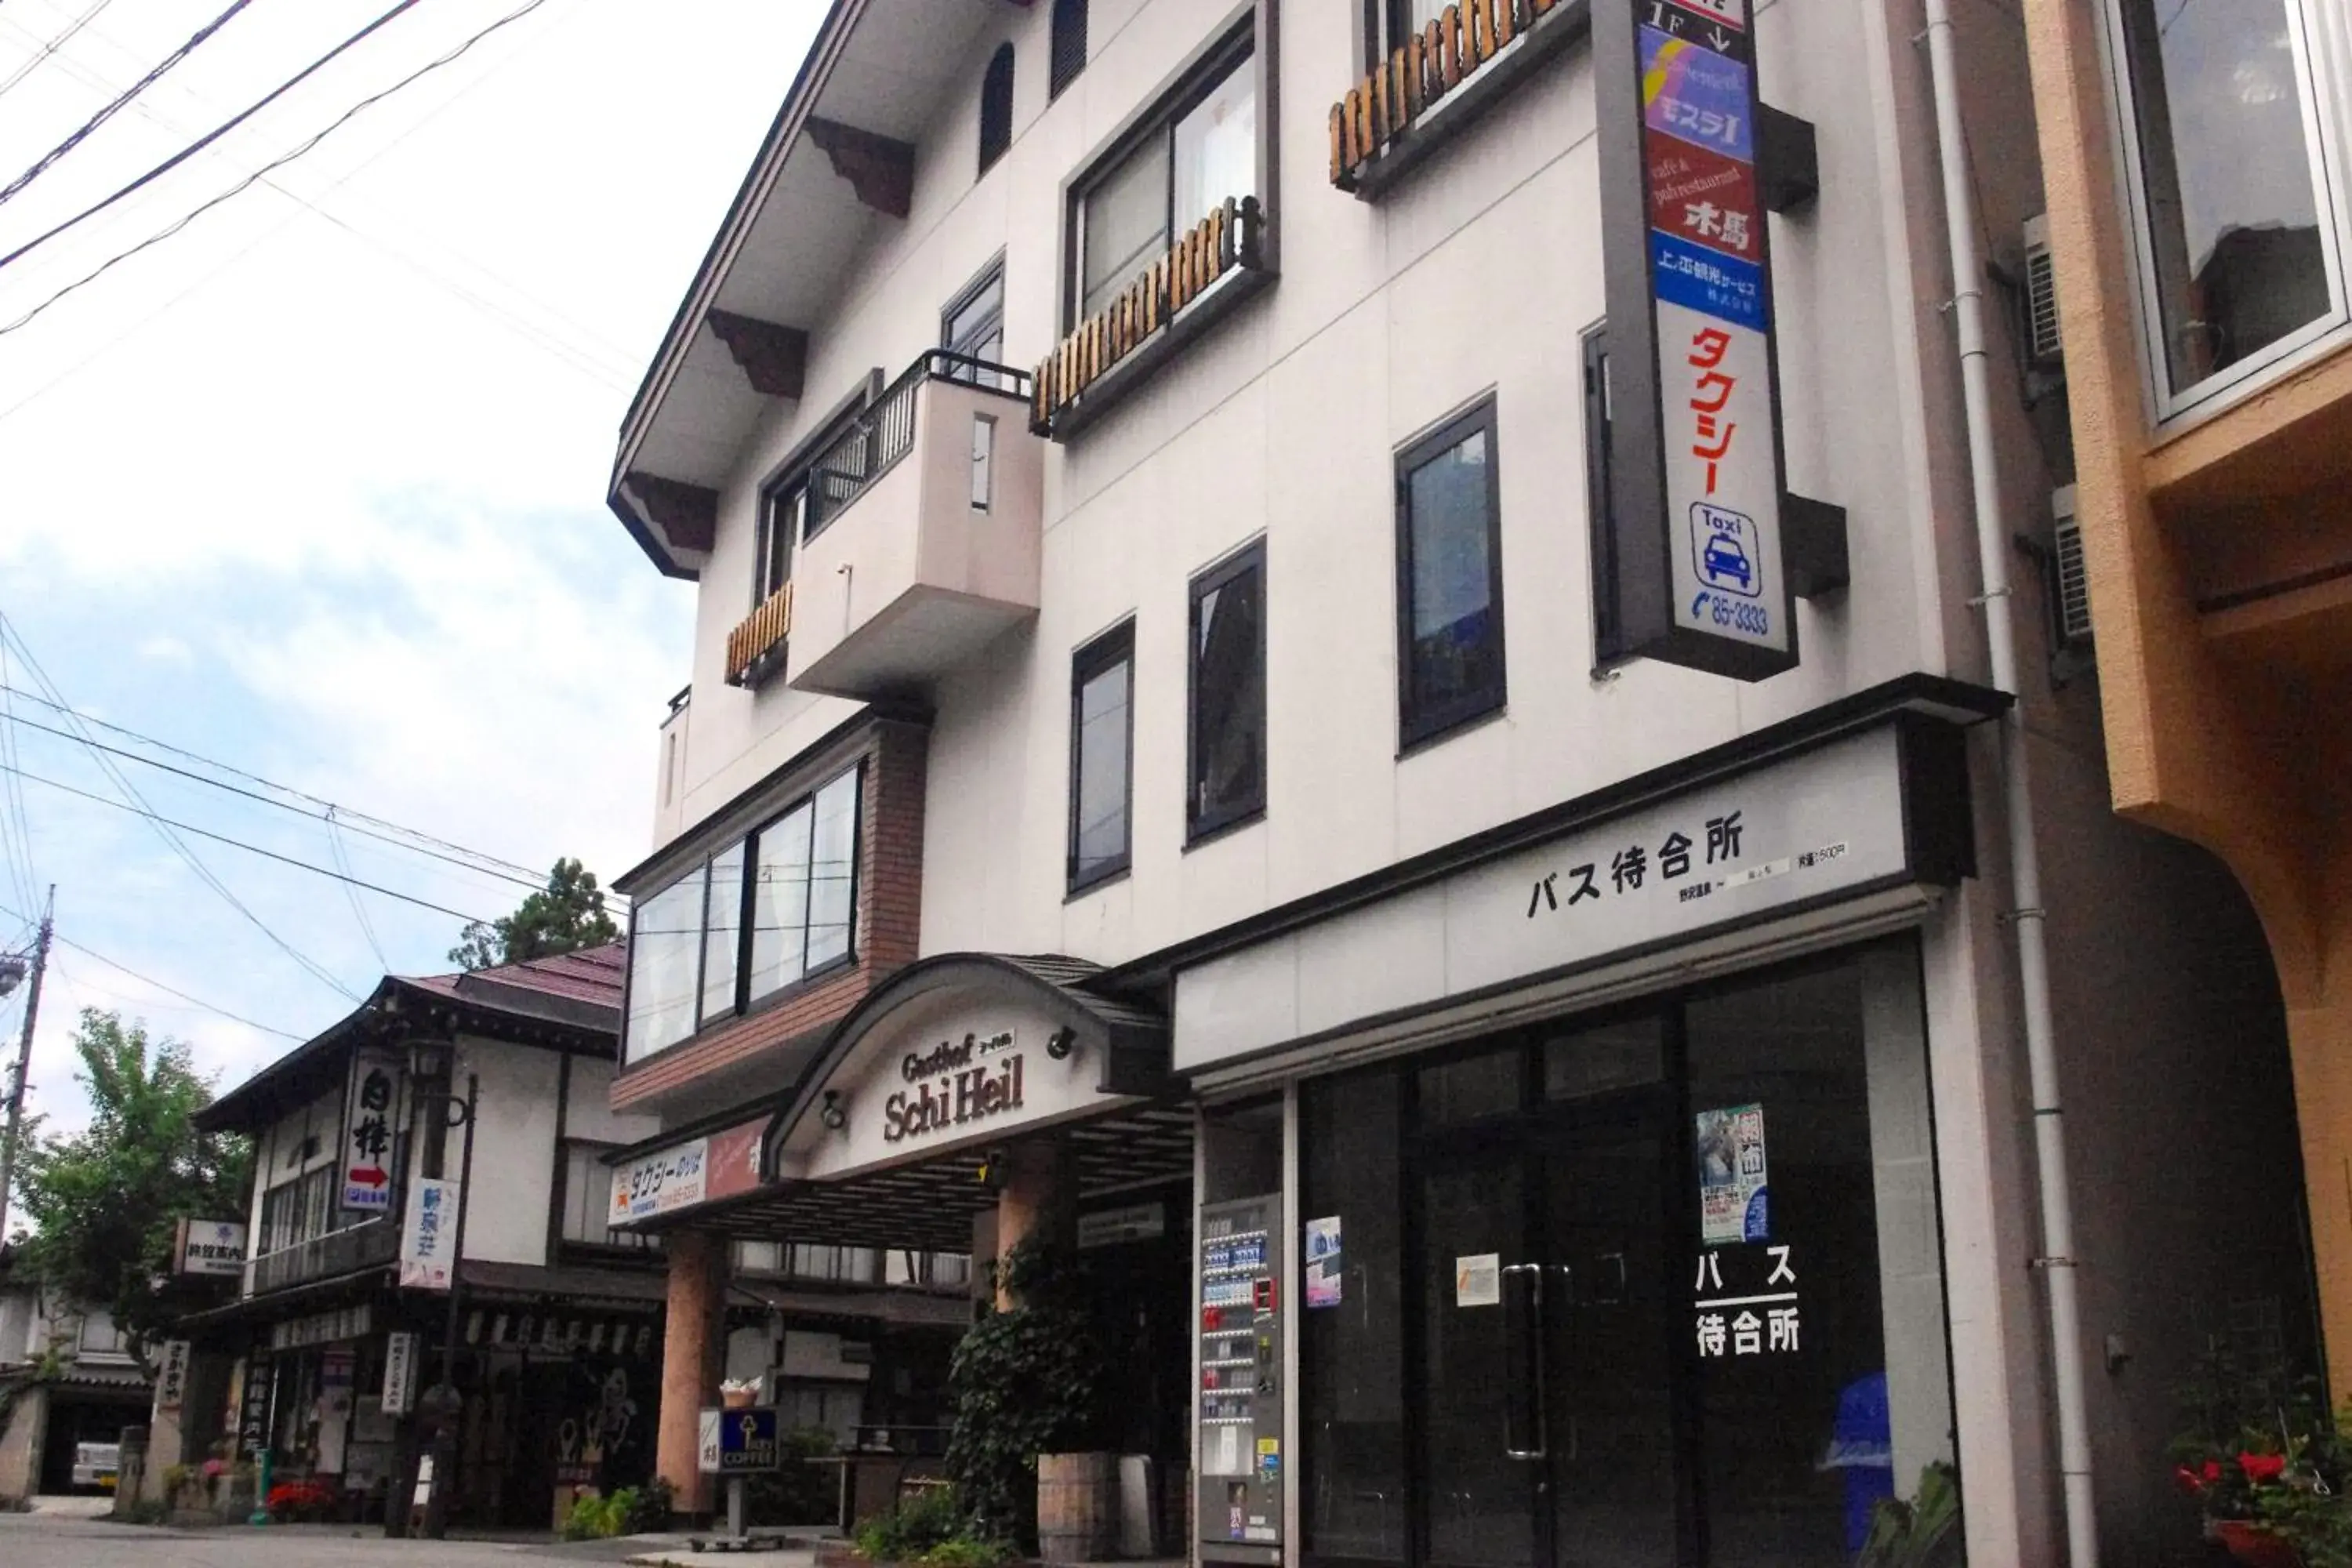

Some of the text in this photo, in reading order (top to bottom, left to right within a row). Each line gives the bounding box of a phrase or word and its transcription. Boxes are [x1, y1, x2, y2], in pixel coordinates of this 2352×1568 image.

[1683, 200, 1750, 250] 木馬
[1688, 326, 1737, 497] タクシー
[1702, 508, 1742, 534] Taxi
[1711, 597, 1768, 635] 85-3333
[1527, 810, 1743, 919] バス待合所
[902, 1033, 975, 1083] Gasthof
[884, 1054, 1025, 1143] Schi Heil
[1695, 1245, 1796, 1291] バス
[1696, 1307, 1800, 1357] 待合所
